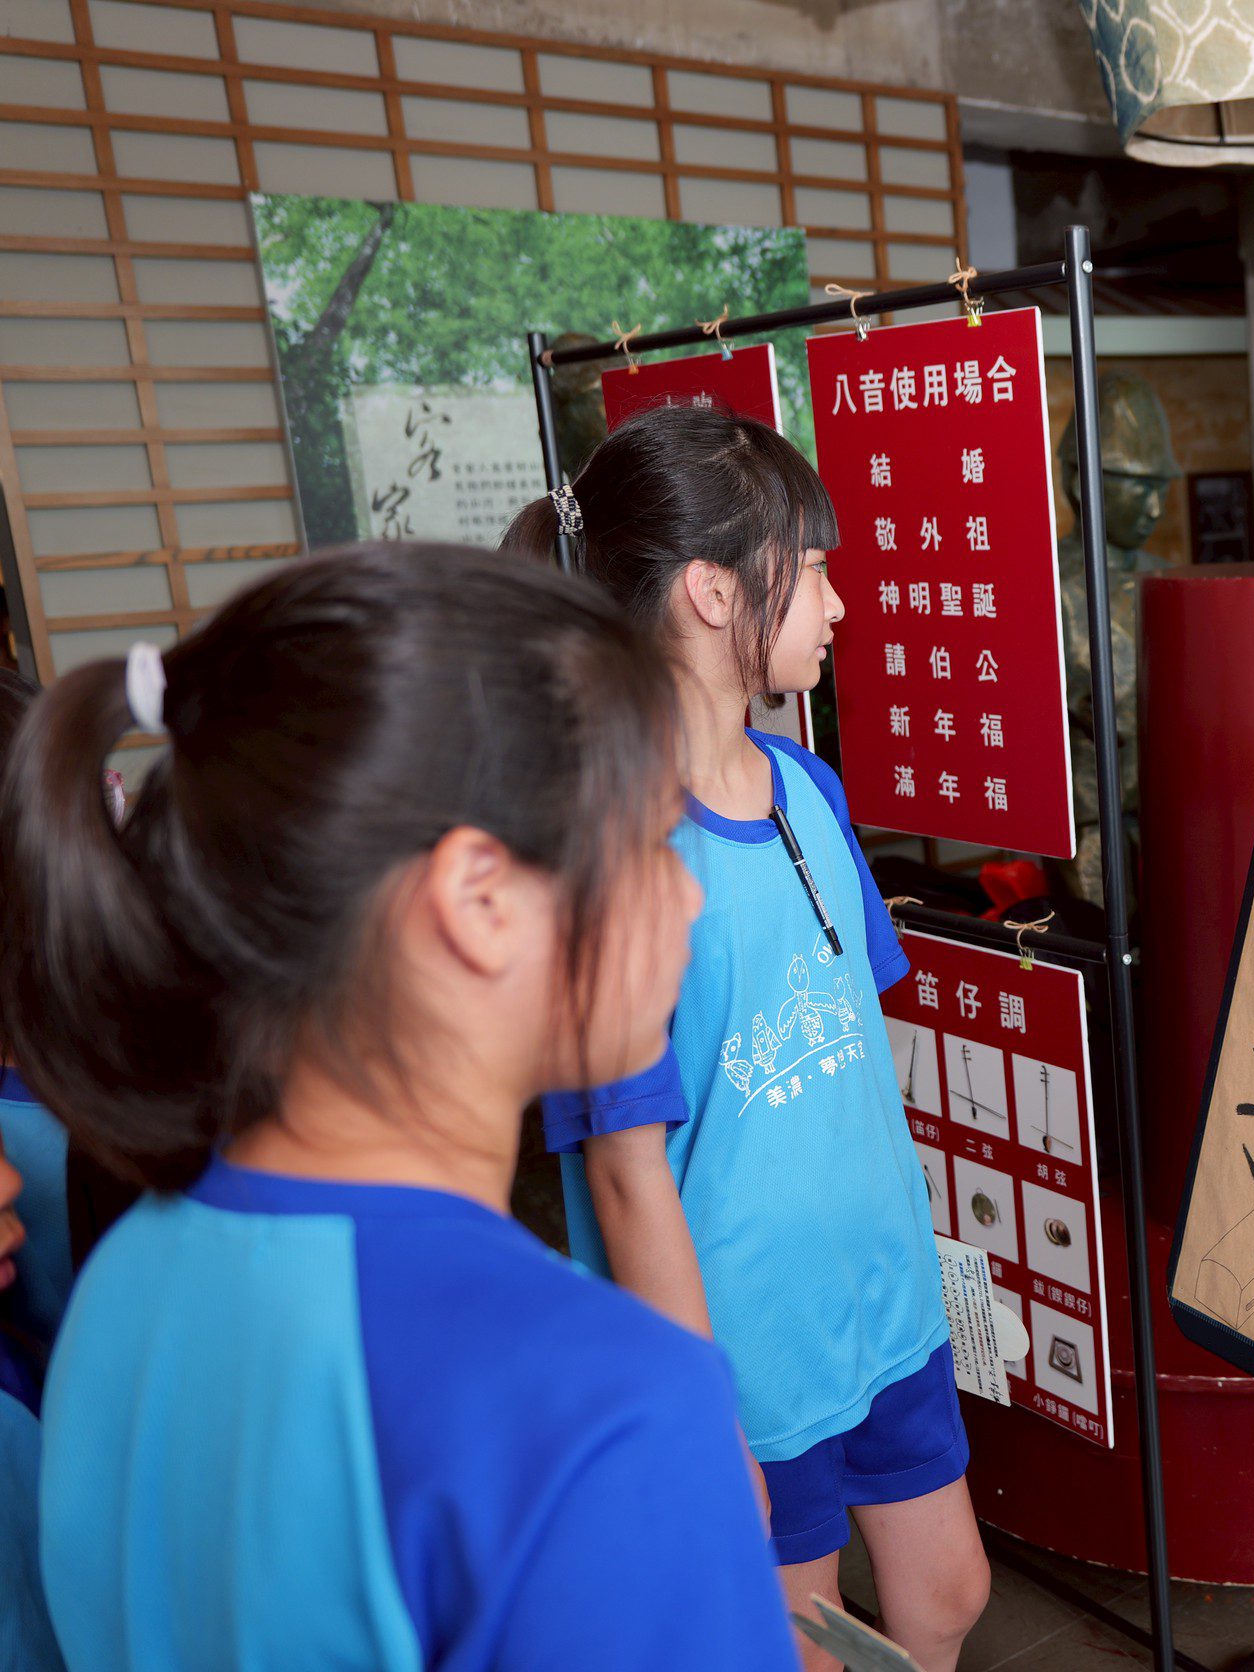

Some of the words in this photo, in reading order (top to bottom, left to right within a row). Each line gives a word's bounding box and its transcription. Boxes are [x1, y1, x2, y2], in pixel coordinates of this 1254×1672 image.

[832, 356, 1017, 416] 八音使用場合
[870, 448, 986, 488] 結婚
[874, 516, 991, 552] 敬外祖
[878, 581, 997, 619] 神明聖誕
[884, 642, 999, 683] 請伯公
[889, 704, 1004, 748] 新年福
[894, 765, 1009, 812] 滿年福
[915, 969, 1027, 1034] 笛仔調
[966, 1138, 994, 1160] 二弦
[1036, 1162, 1068, 1188] 胡弦
